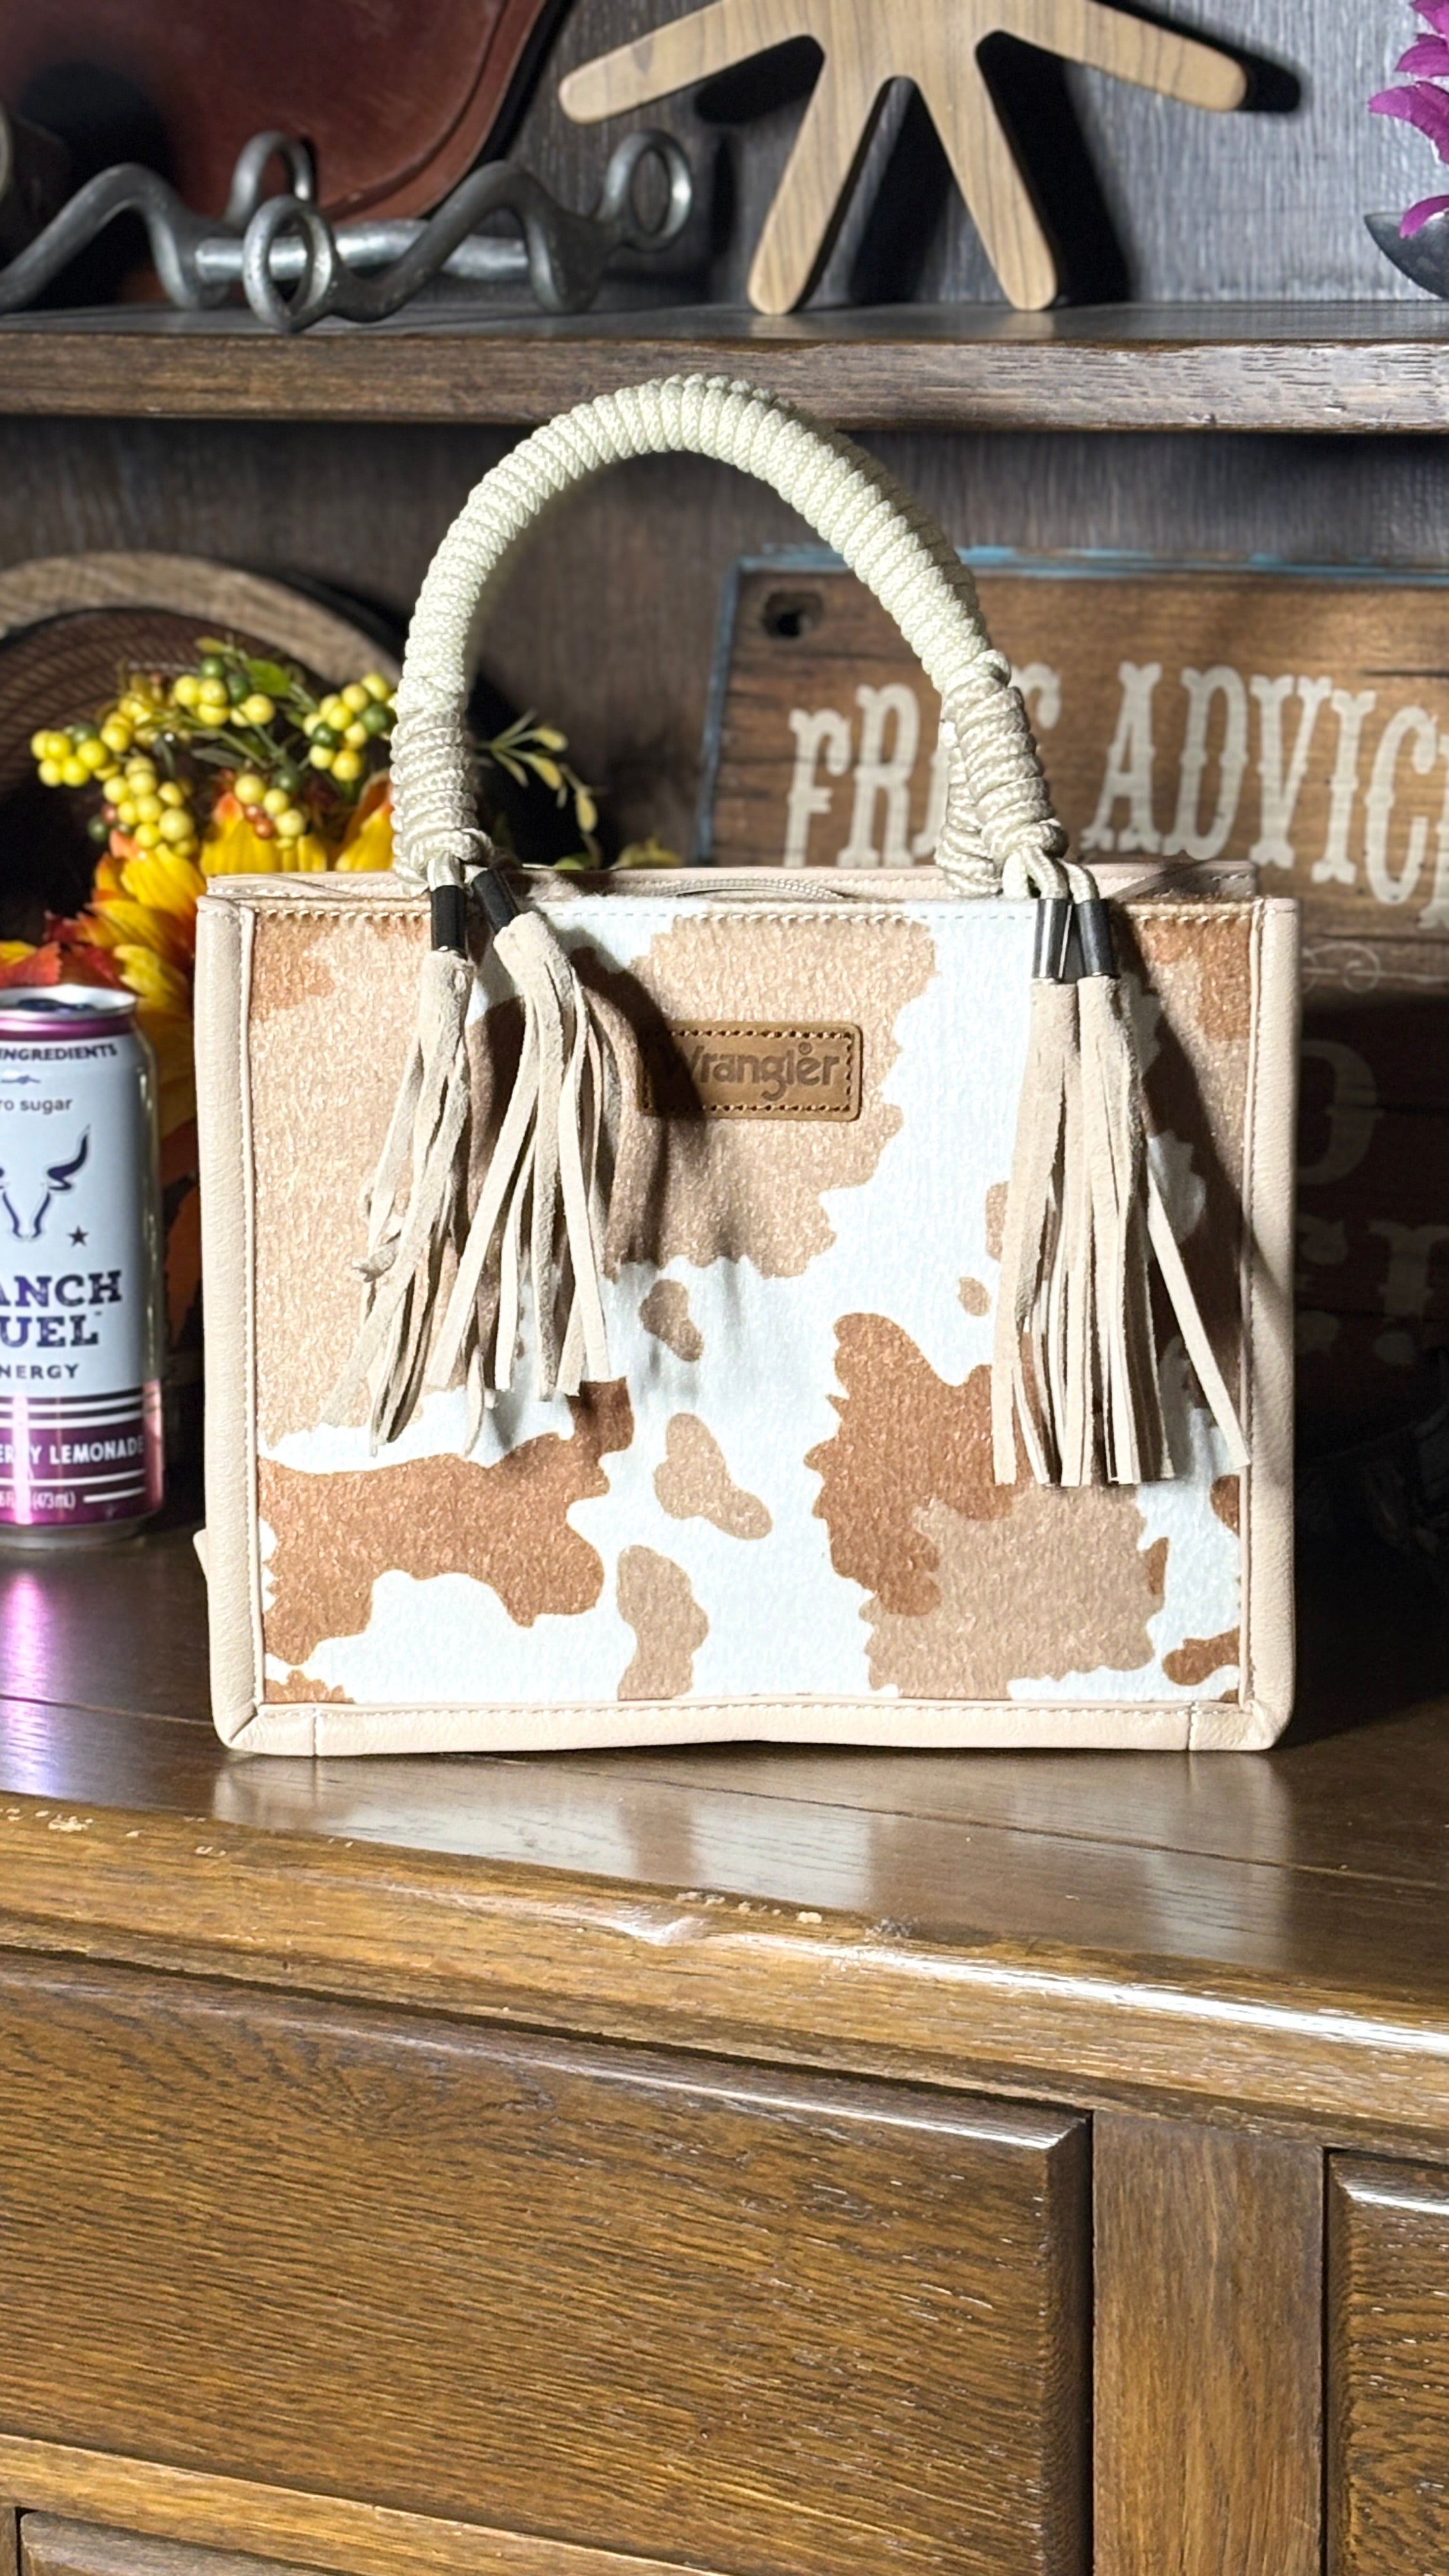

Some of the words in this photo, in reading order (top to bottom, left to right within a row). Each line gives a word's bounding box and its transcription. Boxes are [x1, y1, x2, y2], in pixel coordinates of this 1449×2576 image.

[20, 1099, 73, 1116] sugar
[0, 1443, 42, 1465] RY
[49, 1435, 144, 1466] LEMONADE
